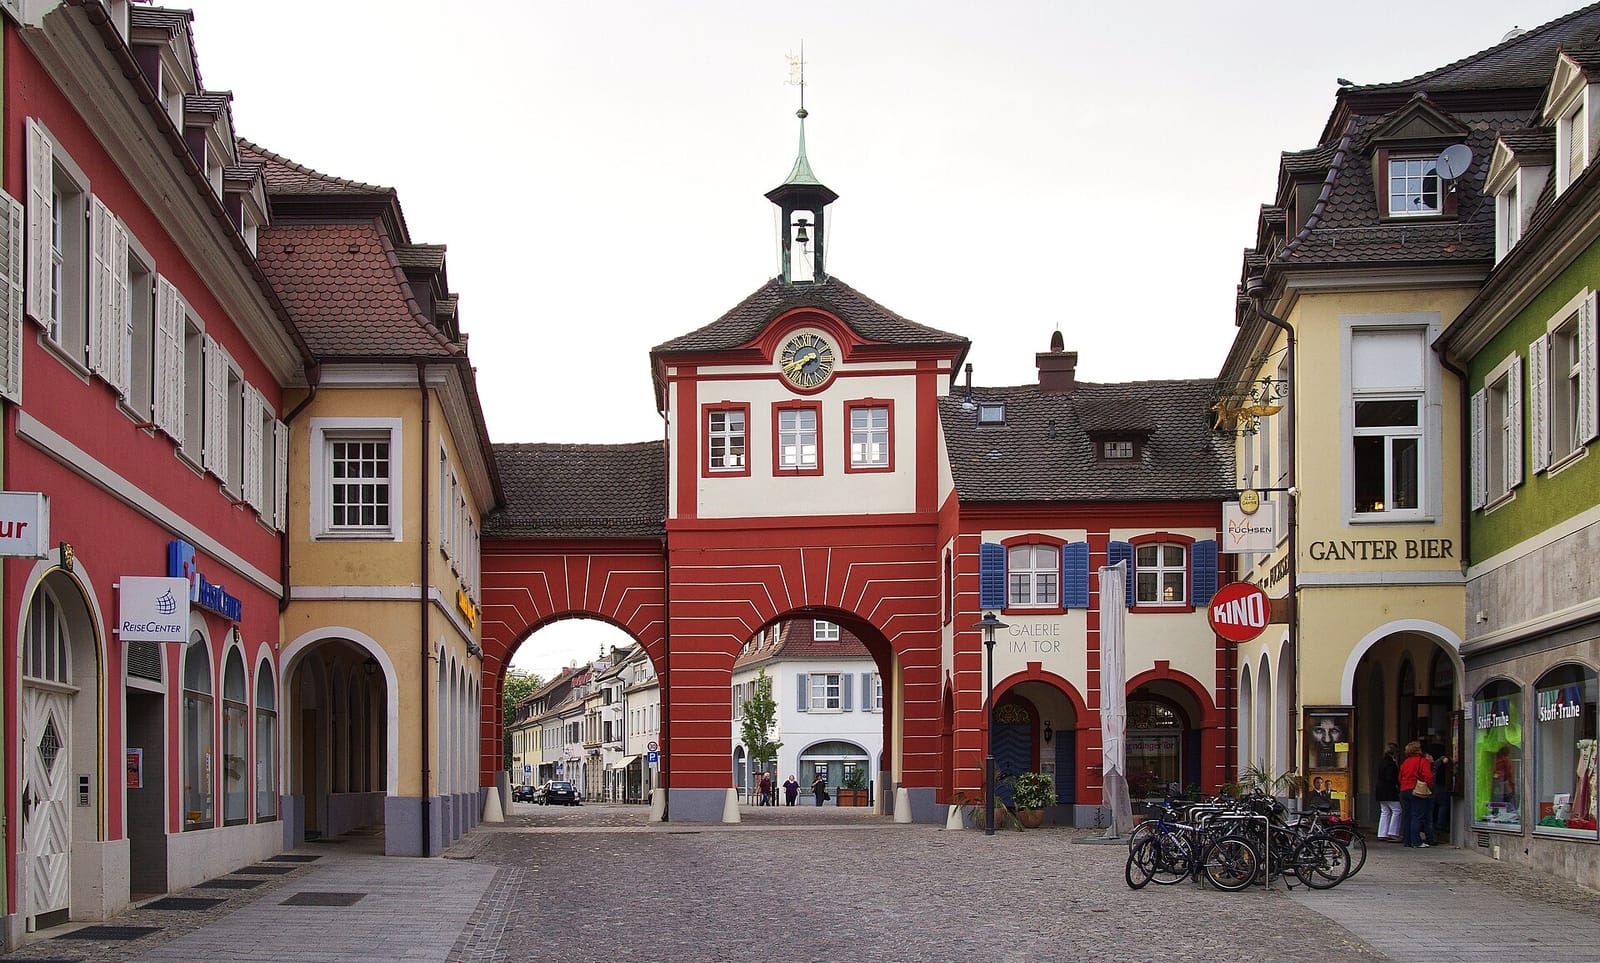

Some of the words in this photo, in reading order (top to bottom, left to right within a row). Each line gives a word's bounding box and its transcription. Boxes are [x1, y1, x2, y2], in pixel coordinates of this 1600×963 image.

[1309, 540, 1399, 561] GANTER
[1405, 538, 1454, 560] BIER
[1213, 592, 1265, 628] KINO
[1009, 624, 1060, 637] GALERIE
[1010, 641, 1027, 653] IM
[1032, 640, 1060, 653] TOR
[1478, 711, 1509, 729] Stoff-Truhe
[1540, 700, 1580, 722] Stoff-Truhe
